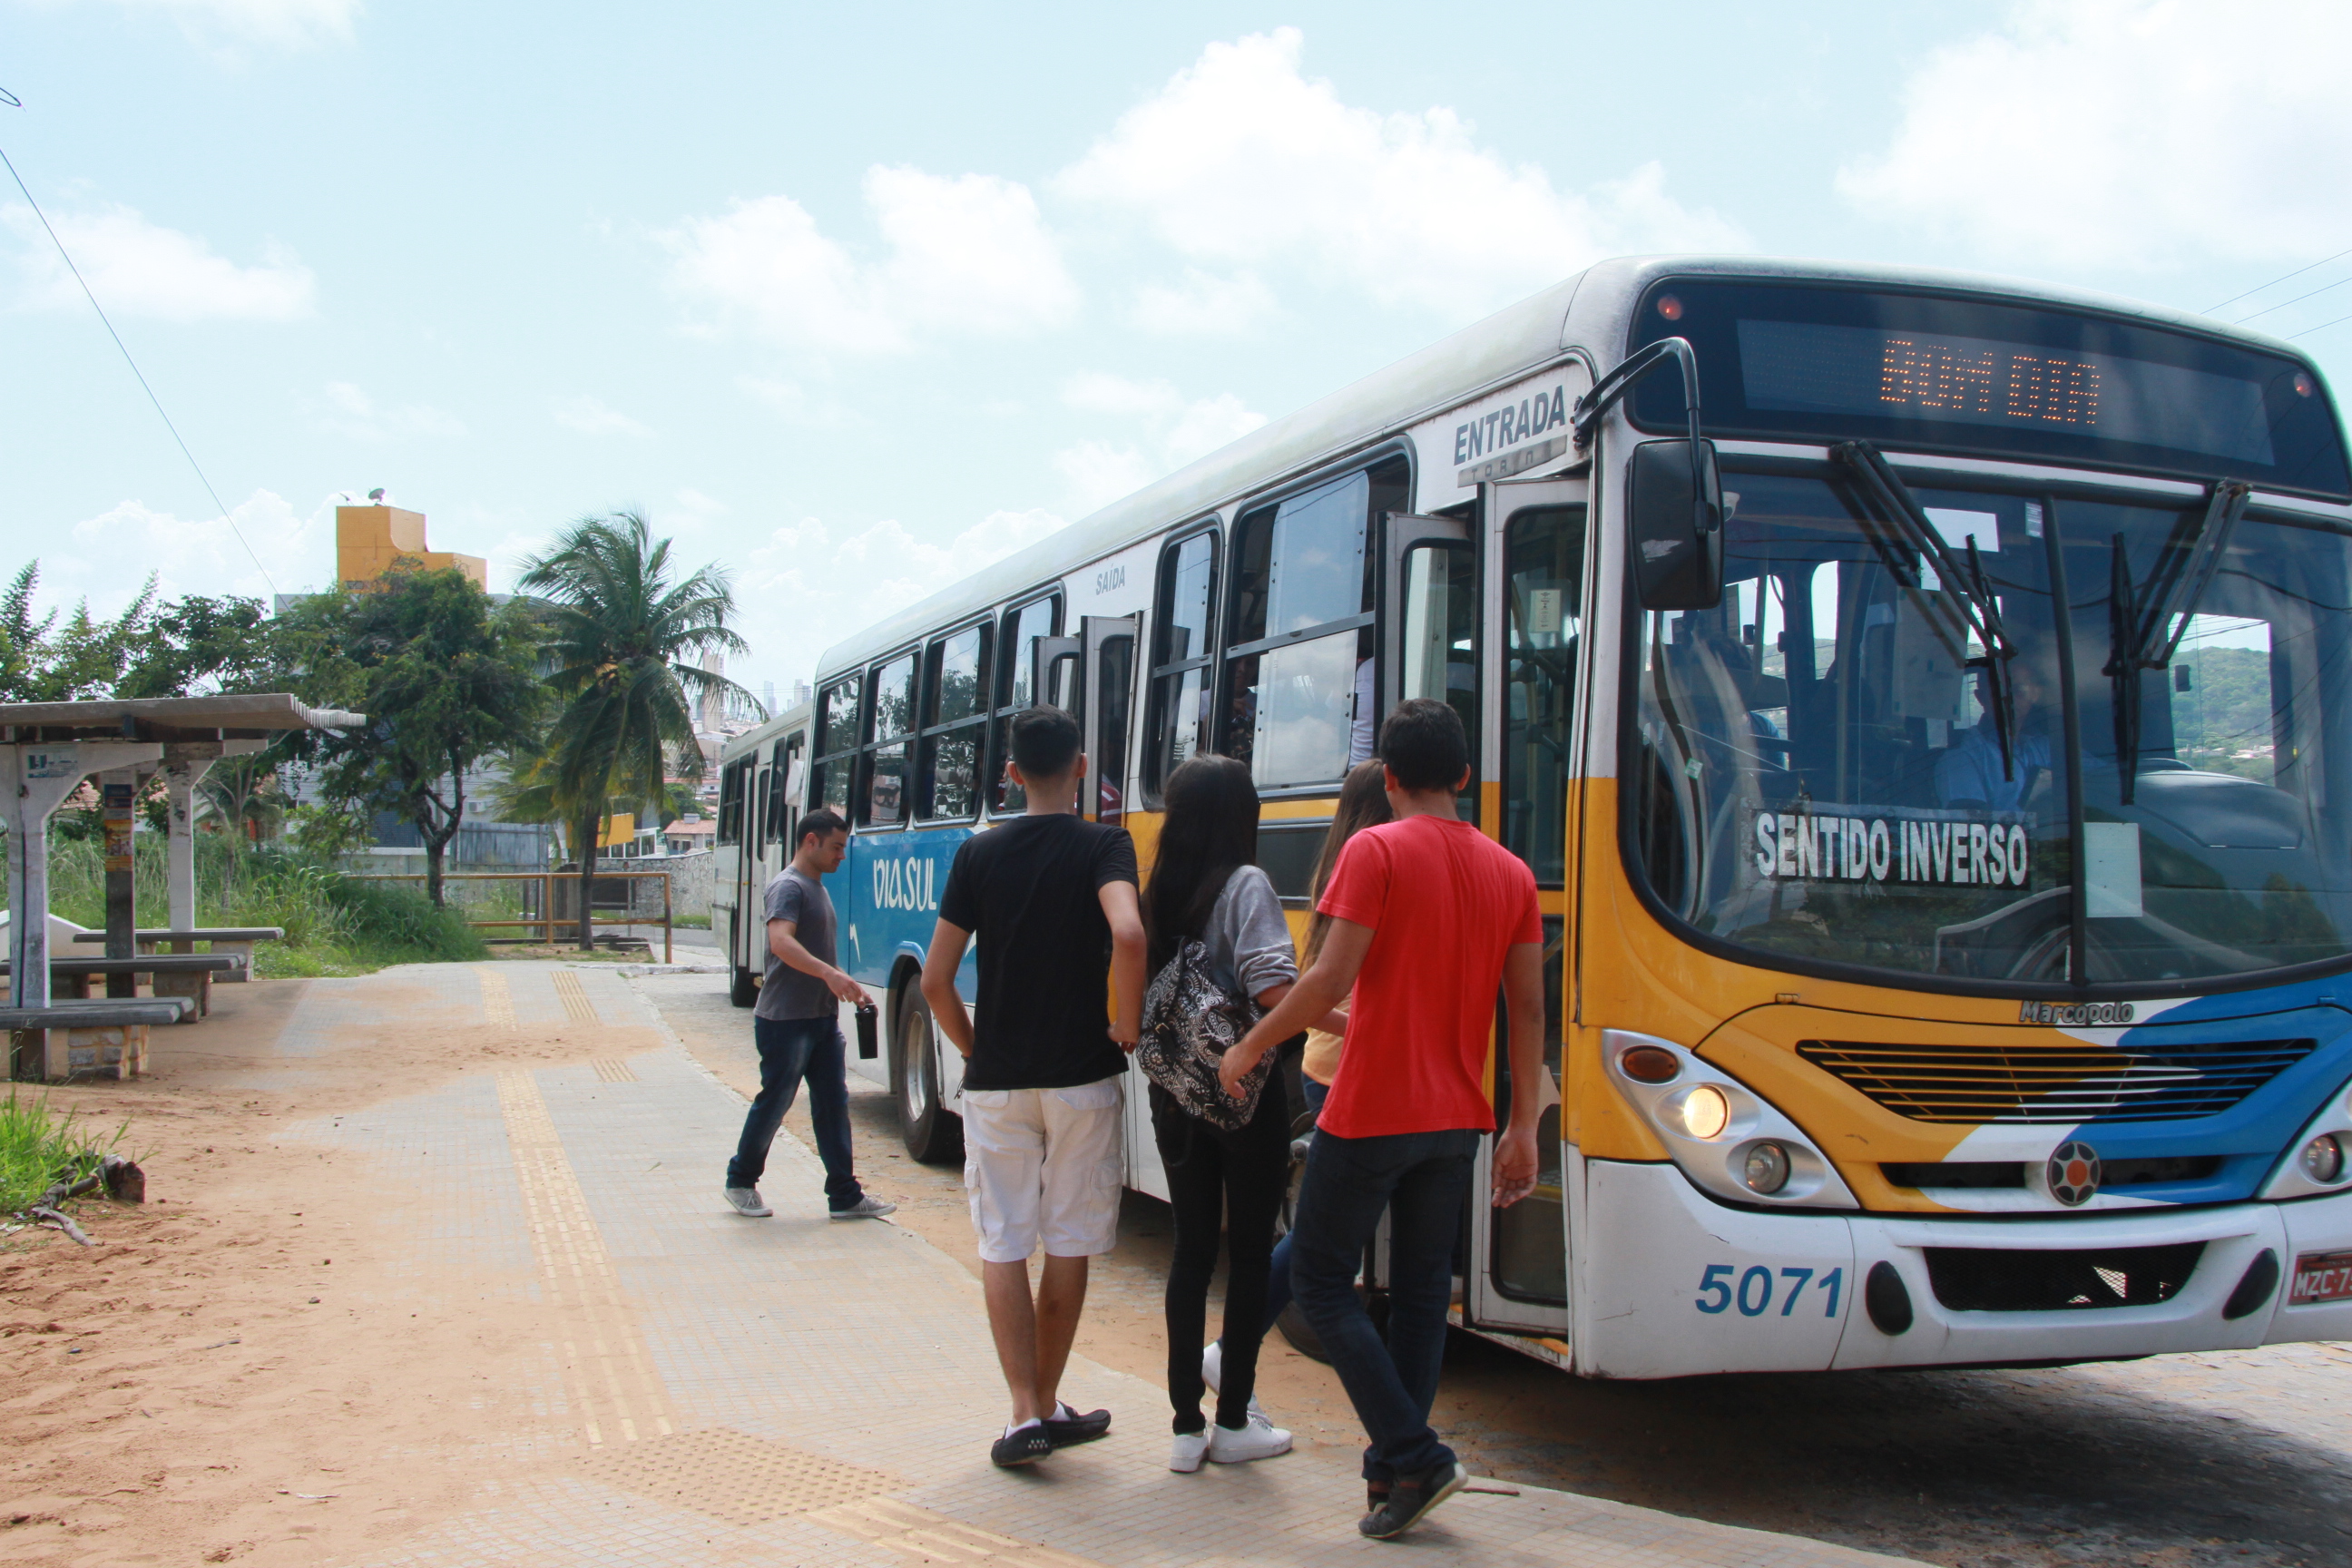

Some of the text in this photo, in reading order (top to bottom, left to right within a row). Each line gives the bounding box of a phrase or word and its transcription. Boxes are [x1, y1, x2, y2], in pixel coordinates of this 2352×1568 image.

[1880, 339, 2101, 425] BOM DIA
[1454, 385, 1566, 466] ENTRADA
[1095, 563, 1126, 596] SAÍDA
[1756, 812, 2028, 887] SENTIDO INVERSO
[2018, 1000, 2134, 1026] Marcopolo
[1694, 1263, 1843, 1318] 5071
